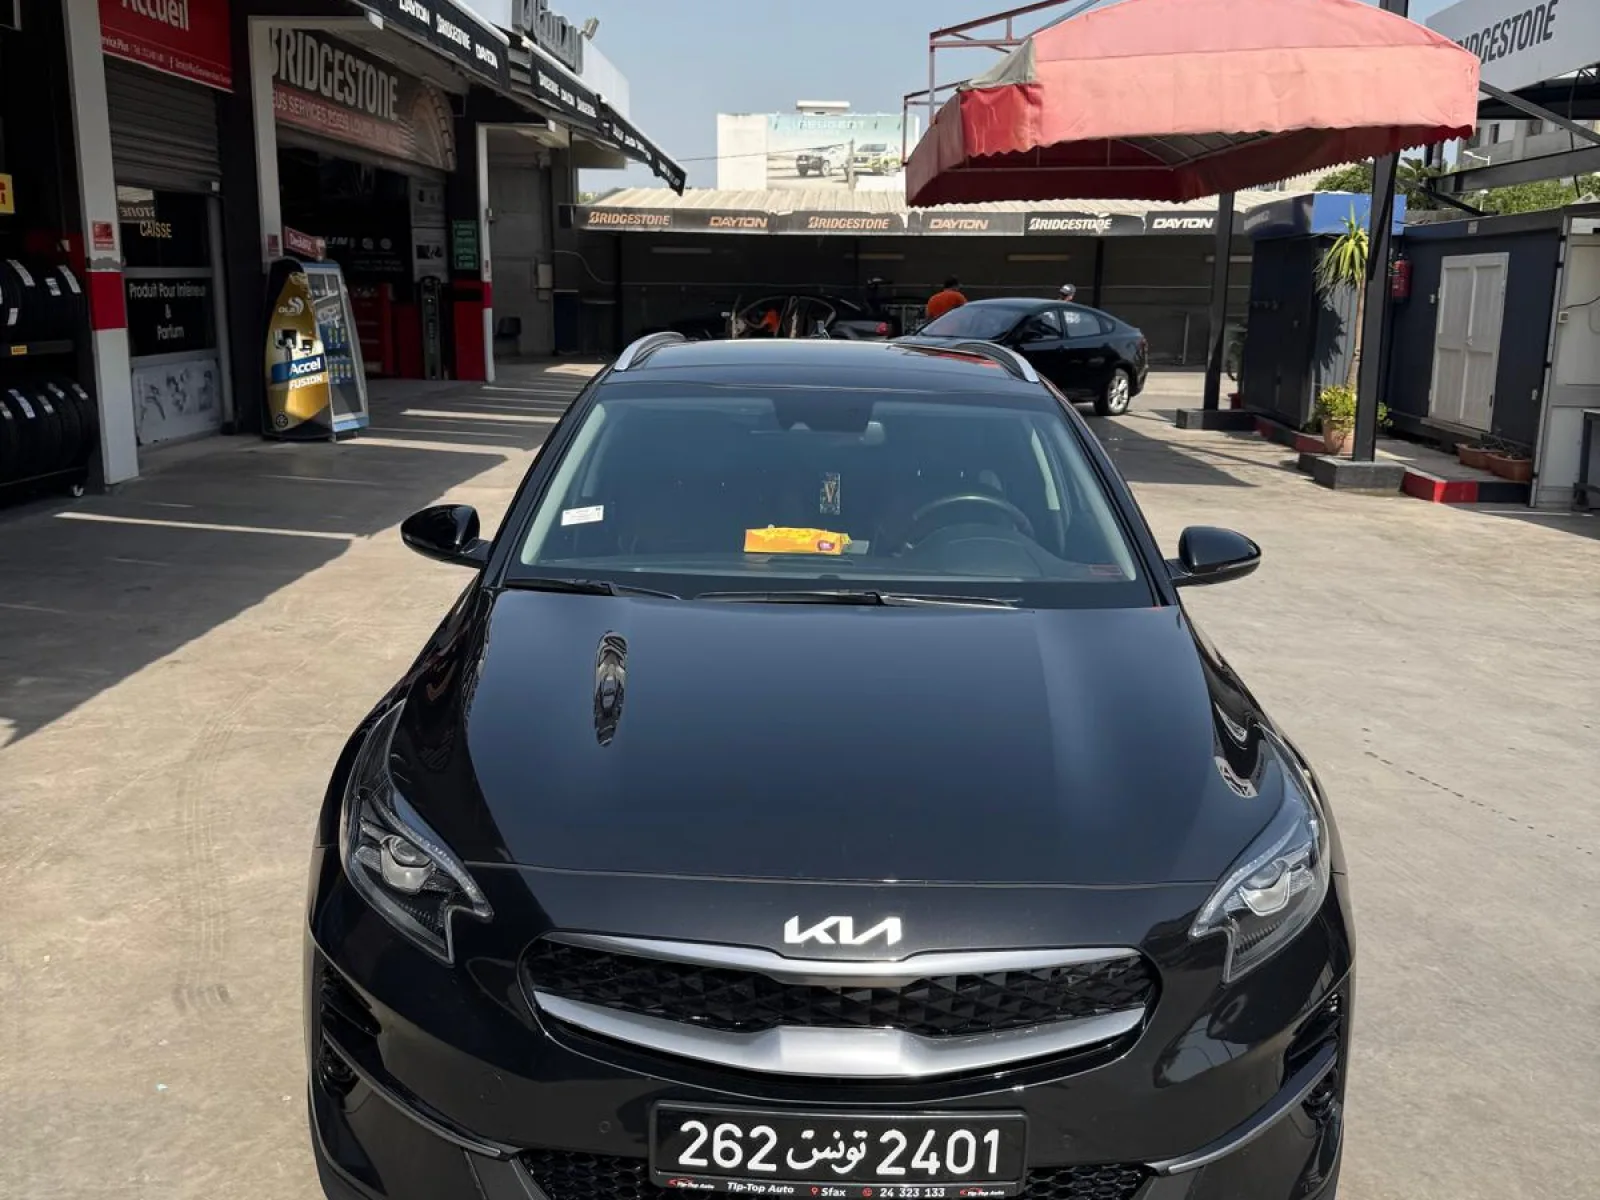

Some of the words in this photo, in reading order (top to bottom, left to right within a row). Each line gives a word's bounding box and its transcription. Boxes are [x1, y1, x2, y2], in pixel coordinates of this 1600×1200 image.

[1453, 0, 1558, 64] DGESTONE
[588, 211, 671, 225] BRIDGESTONE
[709, 216, 768, 228] DAYTON
[808, 216, 890, 229] BRIDGESTONE
[929, 219, 989, 230] DAYTON
[1028, 217, 1112, 231] BRIDGESTONE
[1152, 218, 1214, 229] DAYTON
[140, 220, 173, 239] CAISSE
[128, 282, 157, 300] Produit
[158, 282, 176, 298] Pour
[164, 303, 172, 320] &
[156, 324, 184, 341] Parfum
[289, 357, 321, 377] Accel
[289, 374, 323, 390] FUSION
[784, 915, 901, 947] KIA
[678, 1120, 777, 1172] 262
[786, 1129, 868, 1174] تونس
[876, 1129, 1000, 1175] 2401
[727, 1182, 766, 1193] Tip-Top
[768, 1184, 794, 1194] Auto
[821, 1187, 846, 1197] Sfax
[880, 1187, 894, 1198] 24
[899, 1187, 920, 1198] 323
[924, 1187, 945, 1198] 133
